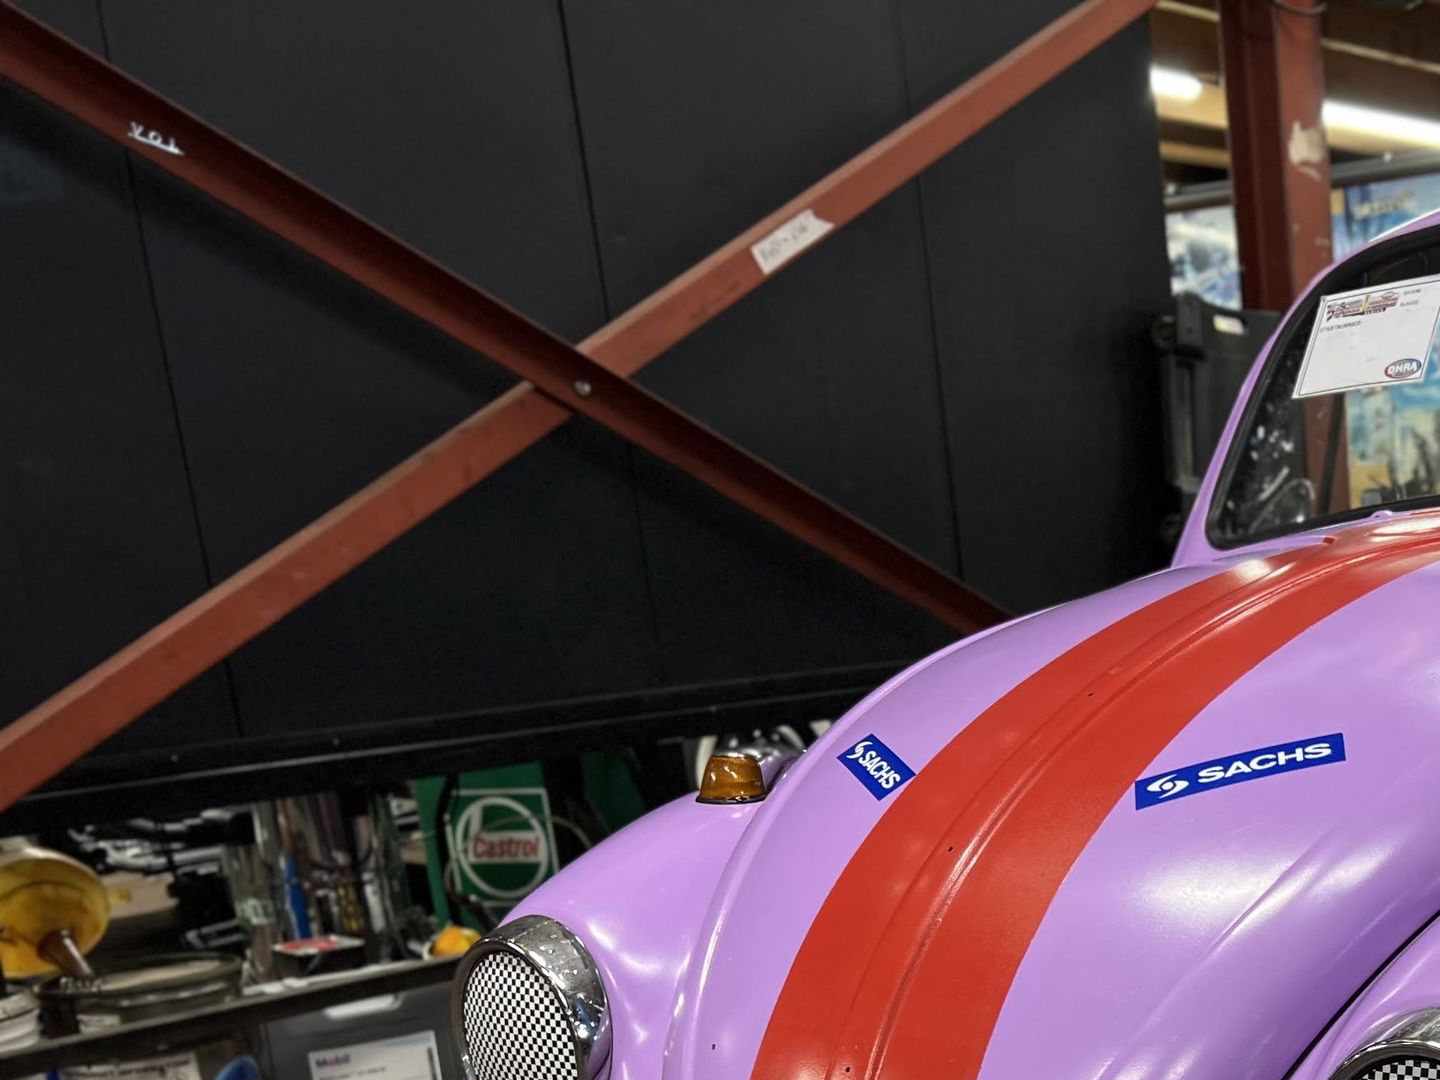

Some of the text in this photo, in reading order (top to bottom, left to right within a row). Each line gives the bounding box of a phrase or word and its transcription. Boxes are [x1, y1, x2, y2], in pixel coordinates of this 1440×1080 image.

[858, 750, 901, 789] SACHS
[1198, 743, 1332, 783] SACHS
[473, 836, 539, 859] Castrol
